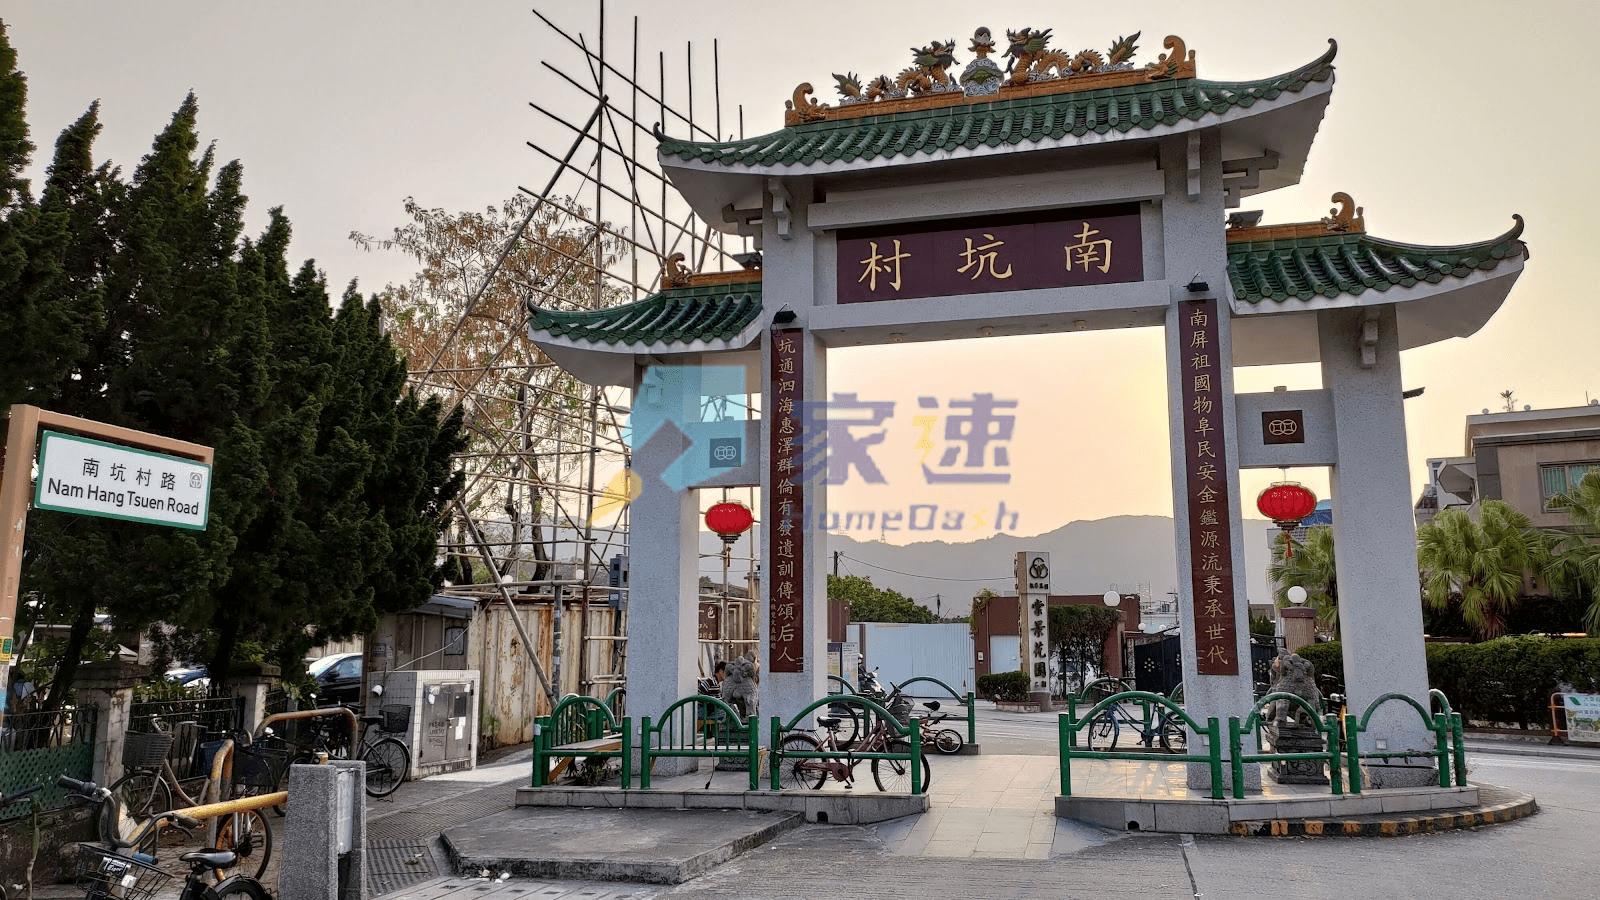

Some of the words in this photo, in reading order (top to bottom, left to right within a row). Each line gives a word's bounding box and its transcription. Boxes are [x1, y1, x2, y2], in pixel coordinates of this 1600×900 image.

[82, 457, 176, 491] 南坑村路
[48, 477, 83, 499] Nam
[87, 484, 125, 507] Hang
[127, 490, 164, 511] Tsuen
[167, 497, 199, 515] Road
